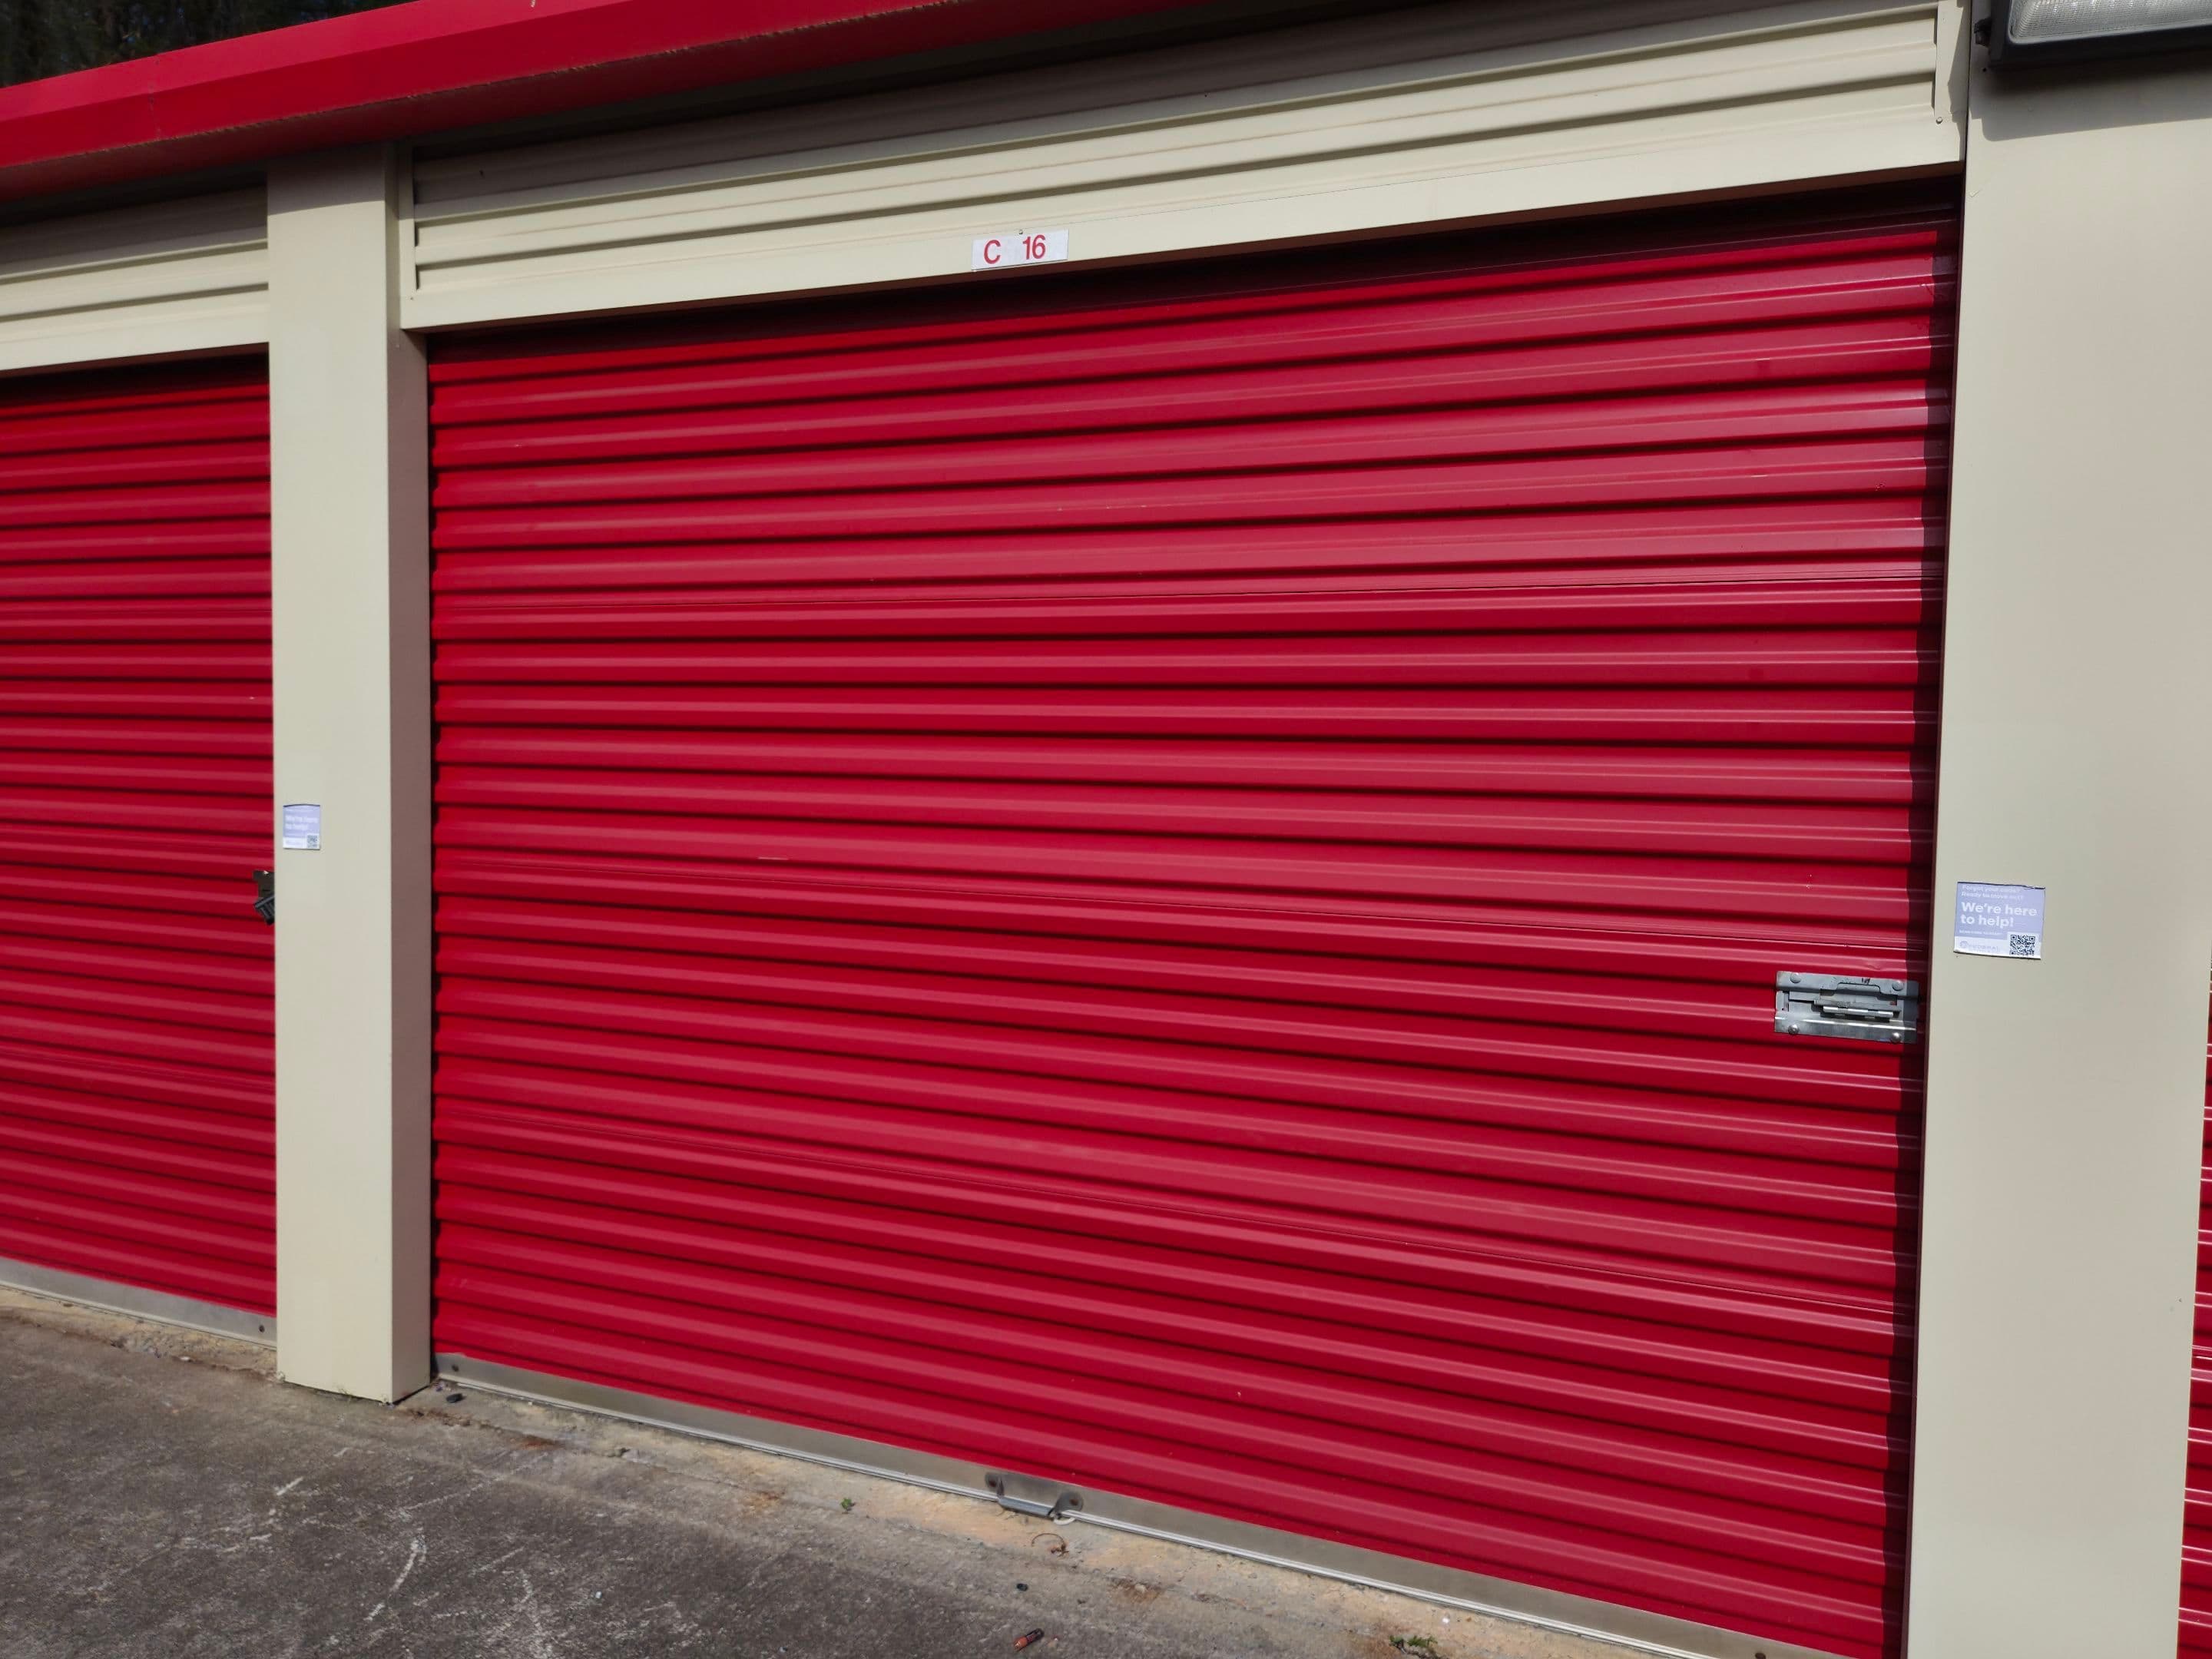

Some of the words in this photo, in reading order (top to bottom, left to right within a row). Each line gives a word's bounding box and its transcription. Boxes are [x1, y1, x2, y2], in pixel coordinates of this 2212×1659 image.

[984, 239, 1001, 264] C
[1022, 234, 1046, 260] 16
[1961, 902, 2002, 914] We're
[2005, 905, 2038, 916] here
[1960, 914, 1975, 924] to
[1978, 915, 2014, 929] help!
